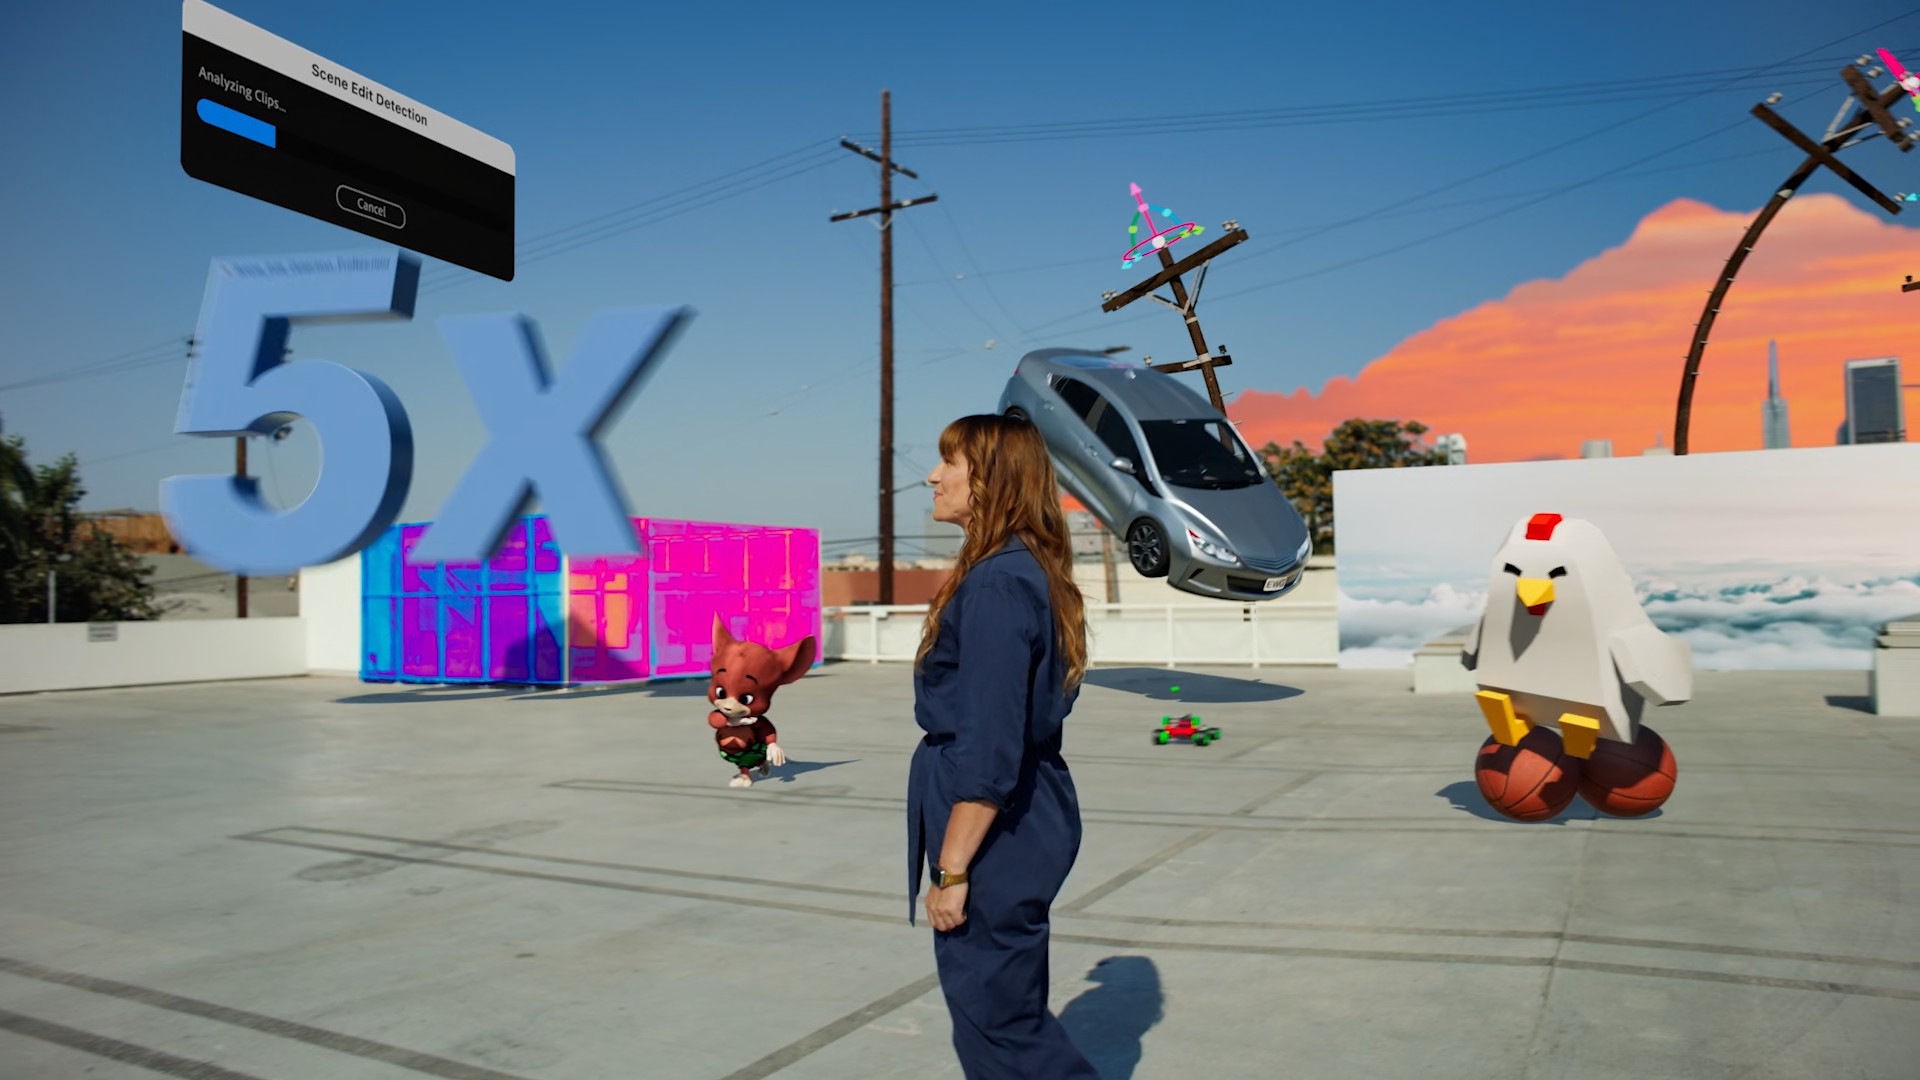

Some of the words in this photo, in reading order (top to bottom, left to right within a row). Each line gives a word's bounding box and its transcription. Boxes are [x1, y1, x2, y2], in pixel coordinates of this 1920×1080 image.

[198, 66, 253, 101] Analyzing
[254, 89, 287, 113] Clips...
[311, 63, 348, 90] Scene
[351, 81, 373, 102] Edit
[376, 93, 428, 126] Detection
[357, 197, 386, 218] Cancel
